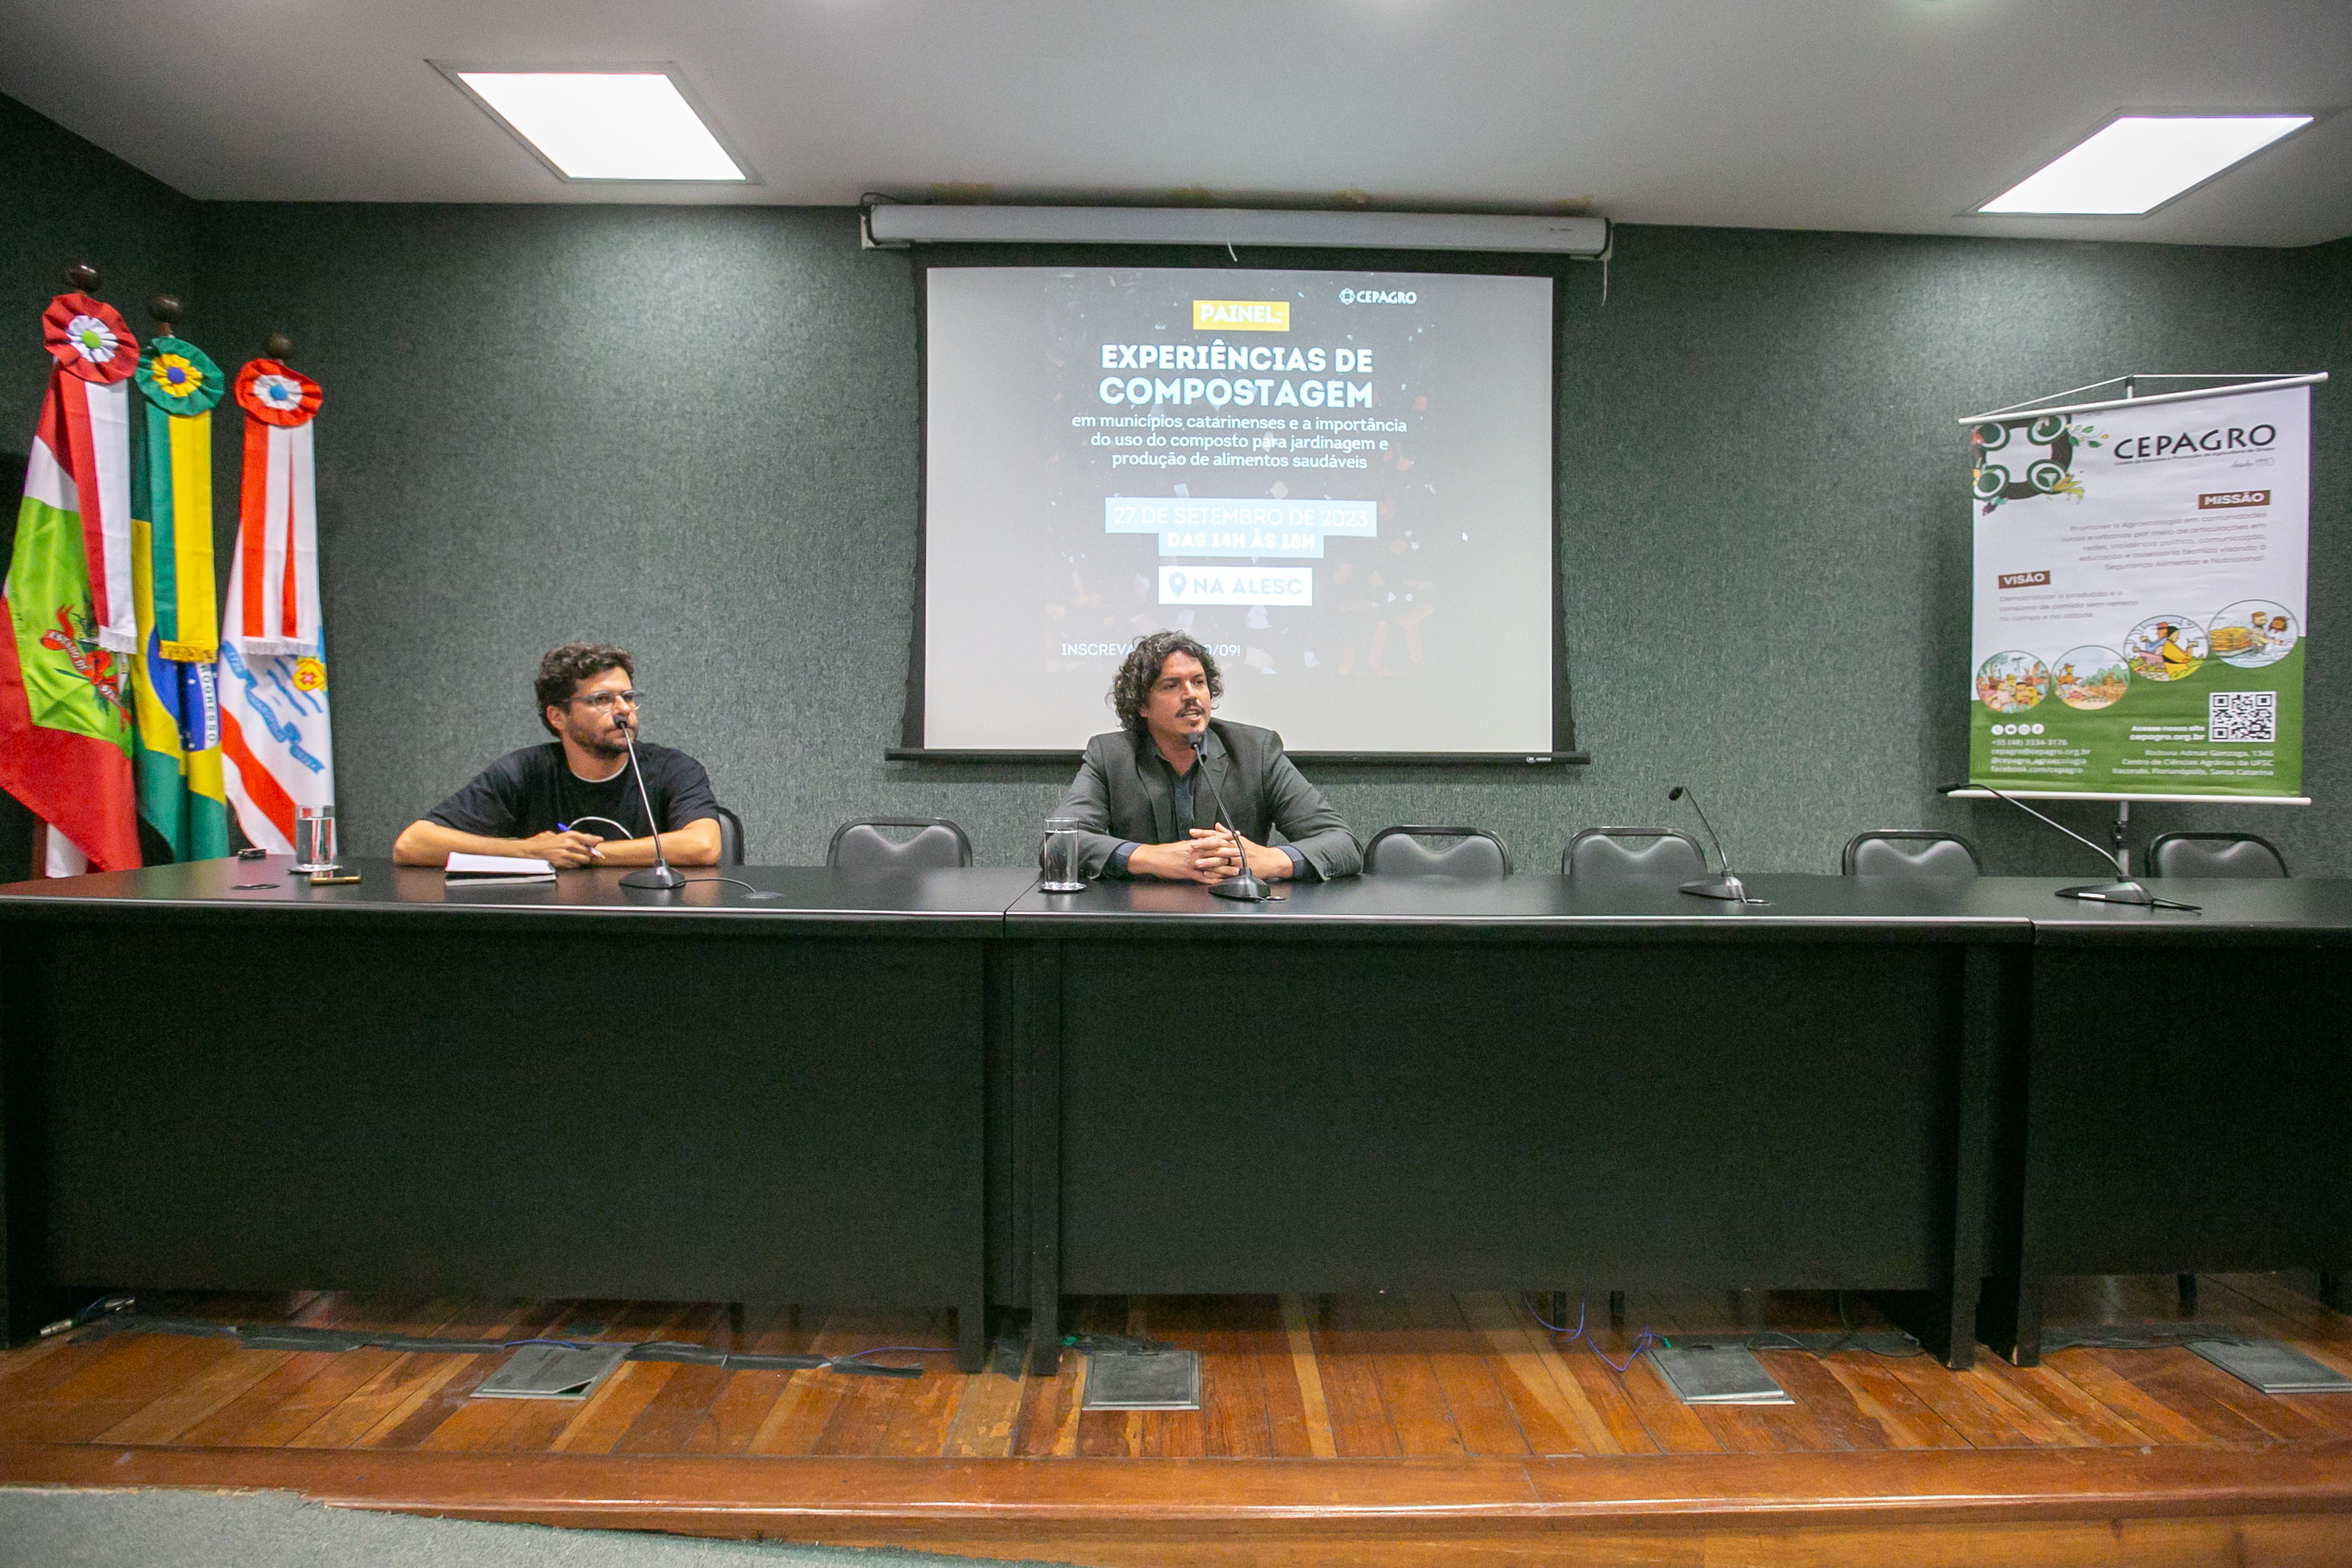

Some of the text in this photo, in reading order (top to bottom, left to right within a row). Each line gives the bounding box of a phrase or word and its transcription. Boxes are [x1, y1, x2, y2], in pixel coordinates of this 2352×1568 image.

[1356, 291, 1417, 304] CEPAGRO
[1200, 304, 1282, 323] PAINEL:
[1101, 338, 1373, 373] EXPERIÊNCIAS DE
[1099, 377, 1373, 408] COMPOSTAGEM
[1072, 414, 1407, 434] em municípios catarinenses e a importância
[1091, 432, 1388, 453] do uso do composto para jardinagem e
[2114, 425, 2276, 459] CEPAGRO
[1112, 452, 1368, 469] produção de alimentos saudáveis
[2204, 491, 2264, 506] MISSÃO
[1114, 507, 1368, 528] 27 DE SETEMBRO DE 2023
[1167, 529, 1315, 549] DAS 14H ÀS 18H
[1193, 577, 1302, 595] NA ALESC
[2004, 573, 2045, 585] VISÃO
[200, 664, 217, 742] ROGRESSO
